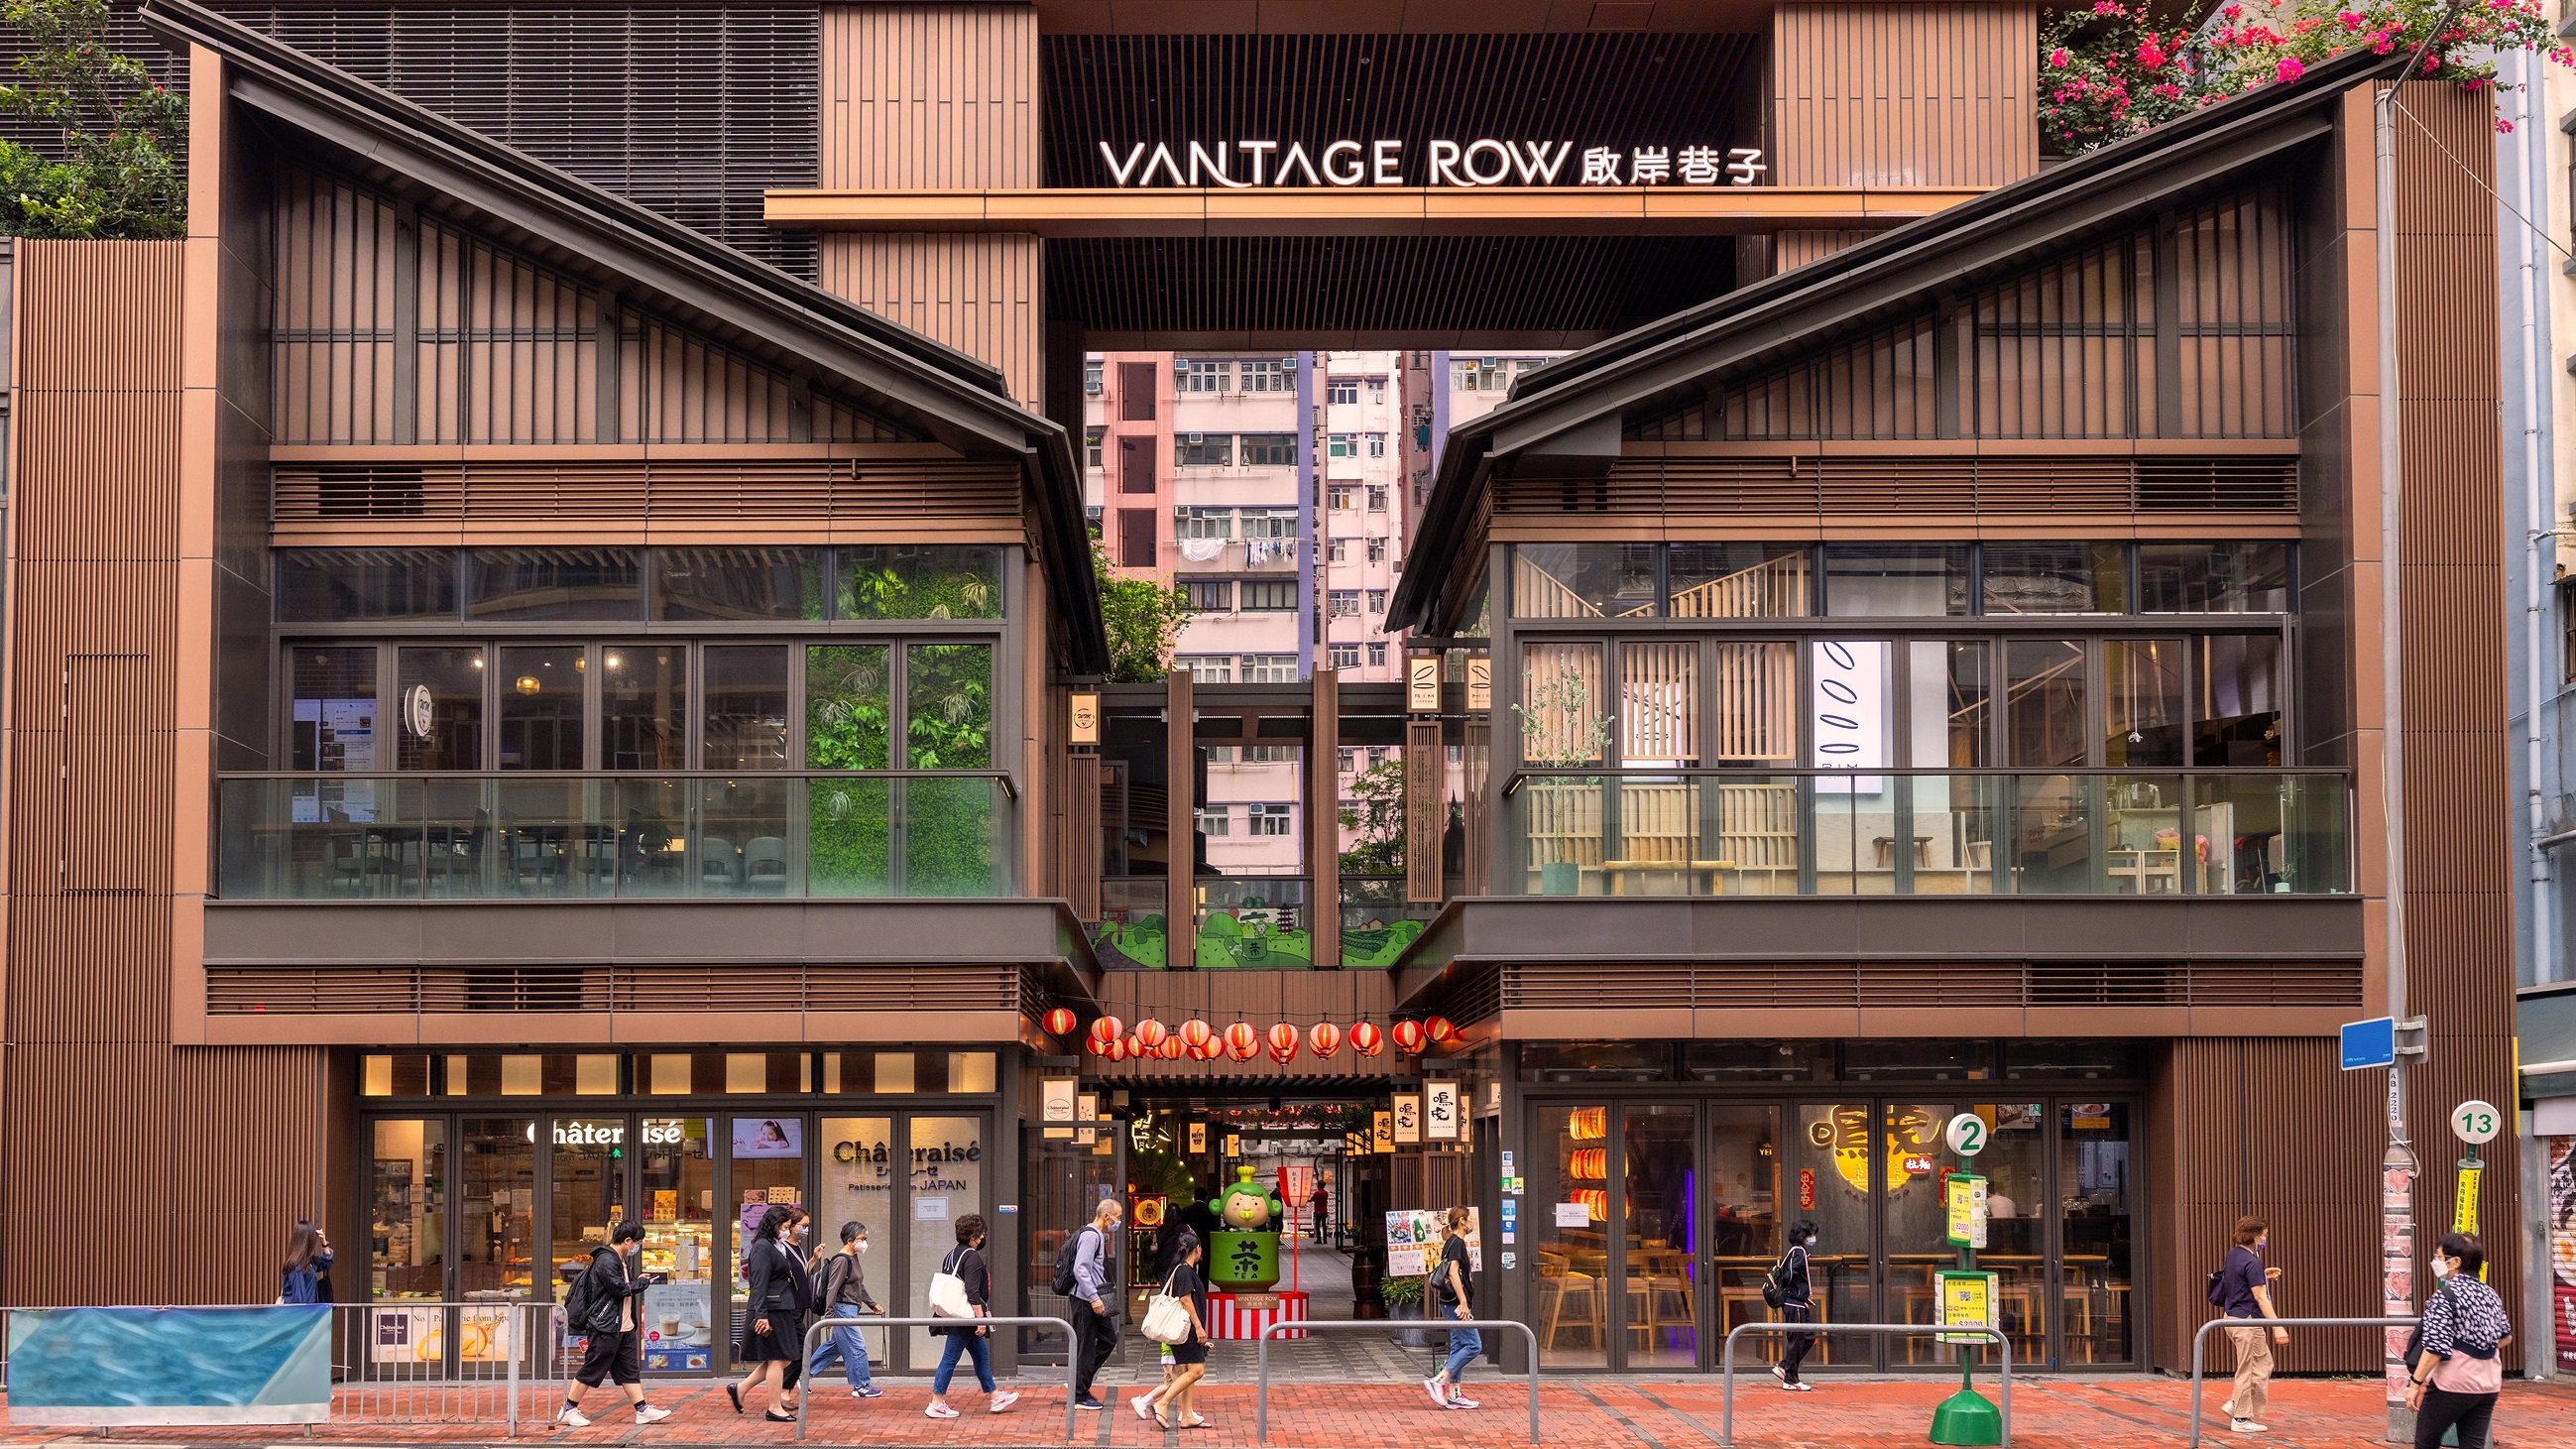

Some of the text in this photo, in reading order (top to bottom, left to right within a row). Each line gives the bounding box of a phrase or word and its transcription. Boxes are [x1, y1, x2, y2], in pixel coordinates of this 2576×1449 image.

[1099, 140, 1574, 187] VANTAGE ROW
[1580, 145, 1767, 186] 啟岸巷子
[1959, 1121, 1981, 1151] 2
[2461, 1113, 2493, 1135] 13
[920, 1179, 967, 1191] JAPAN
[1800, 1172, 1811, 1205] 出入平安
[1230, 1240, 1262, 1272] 茶
